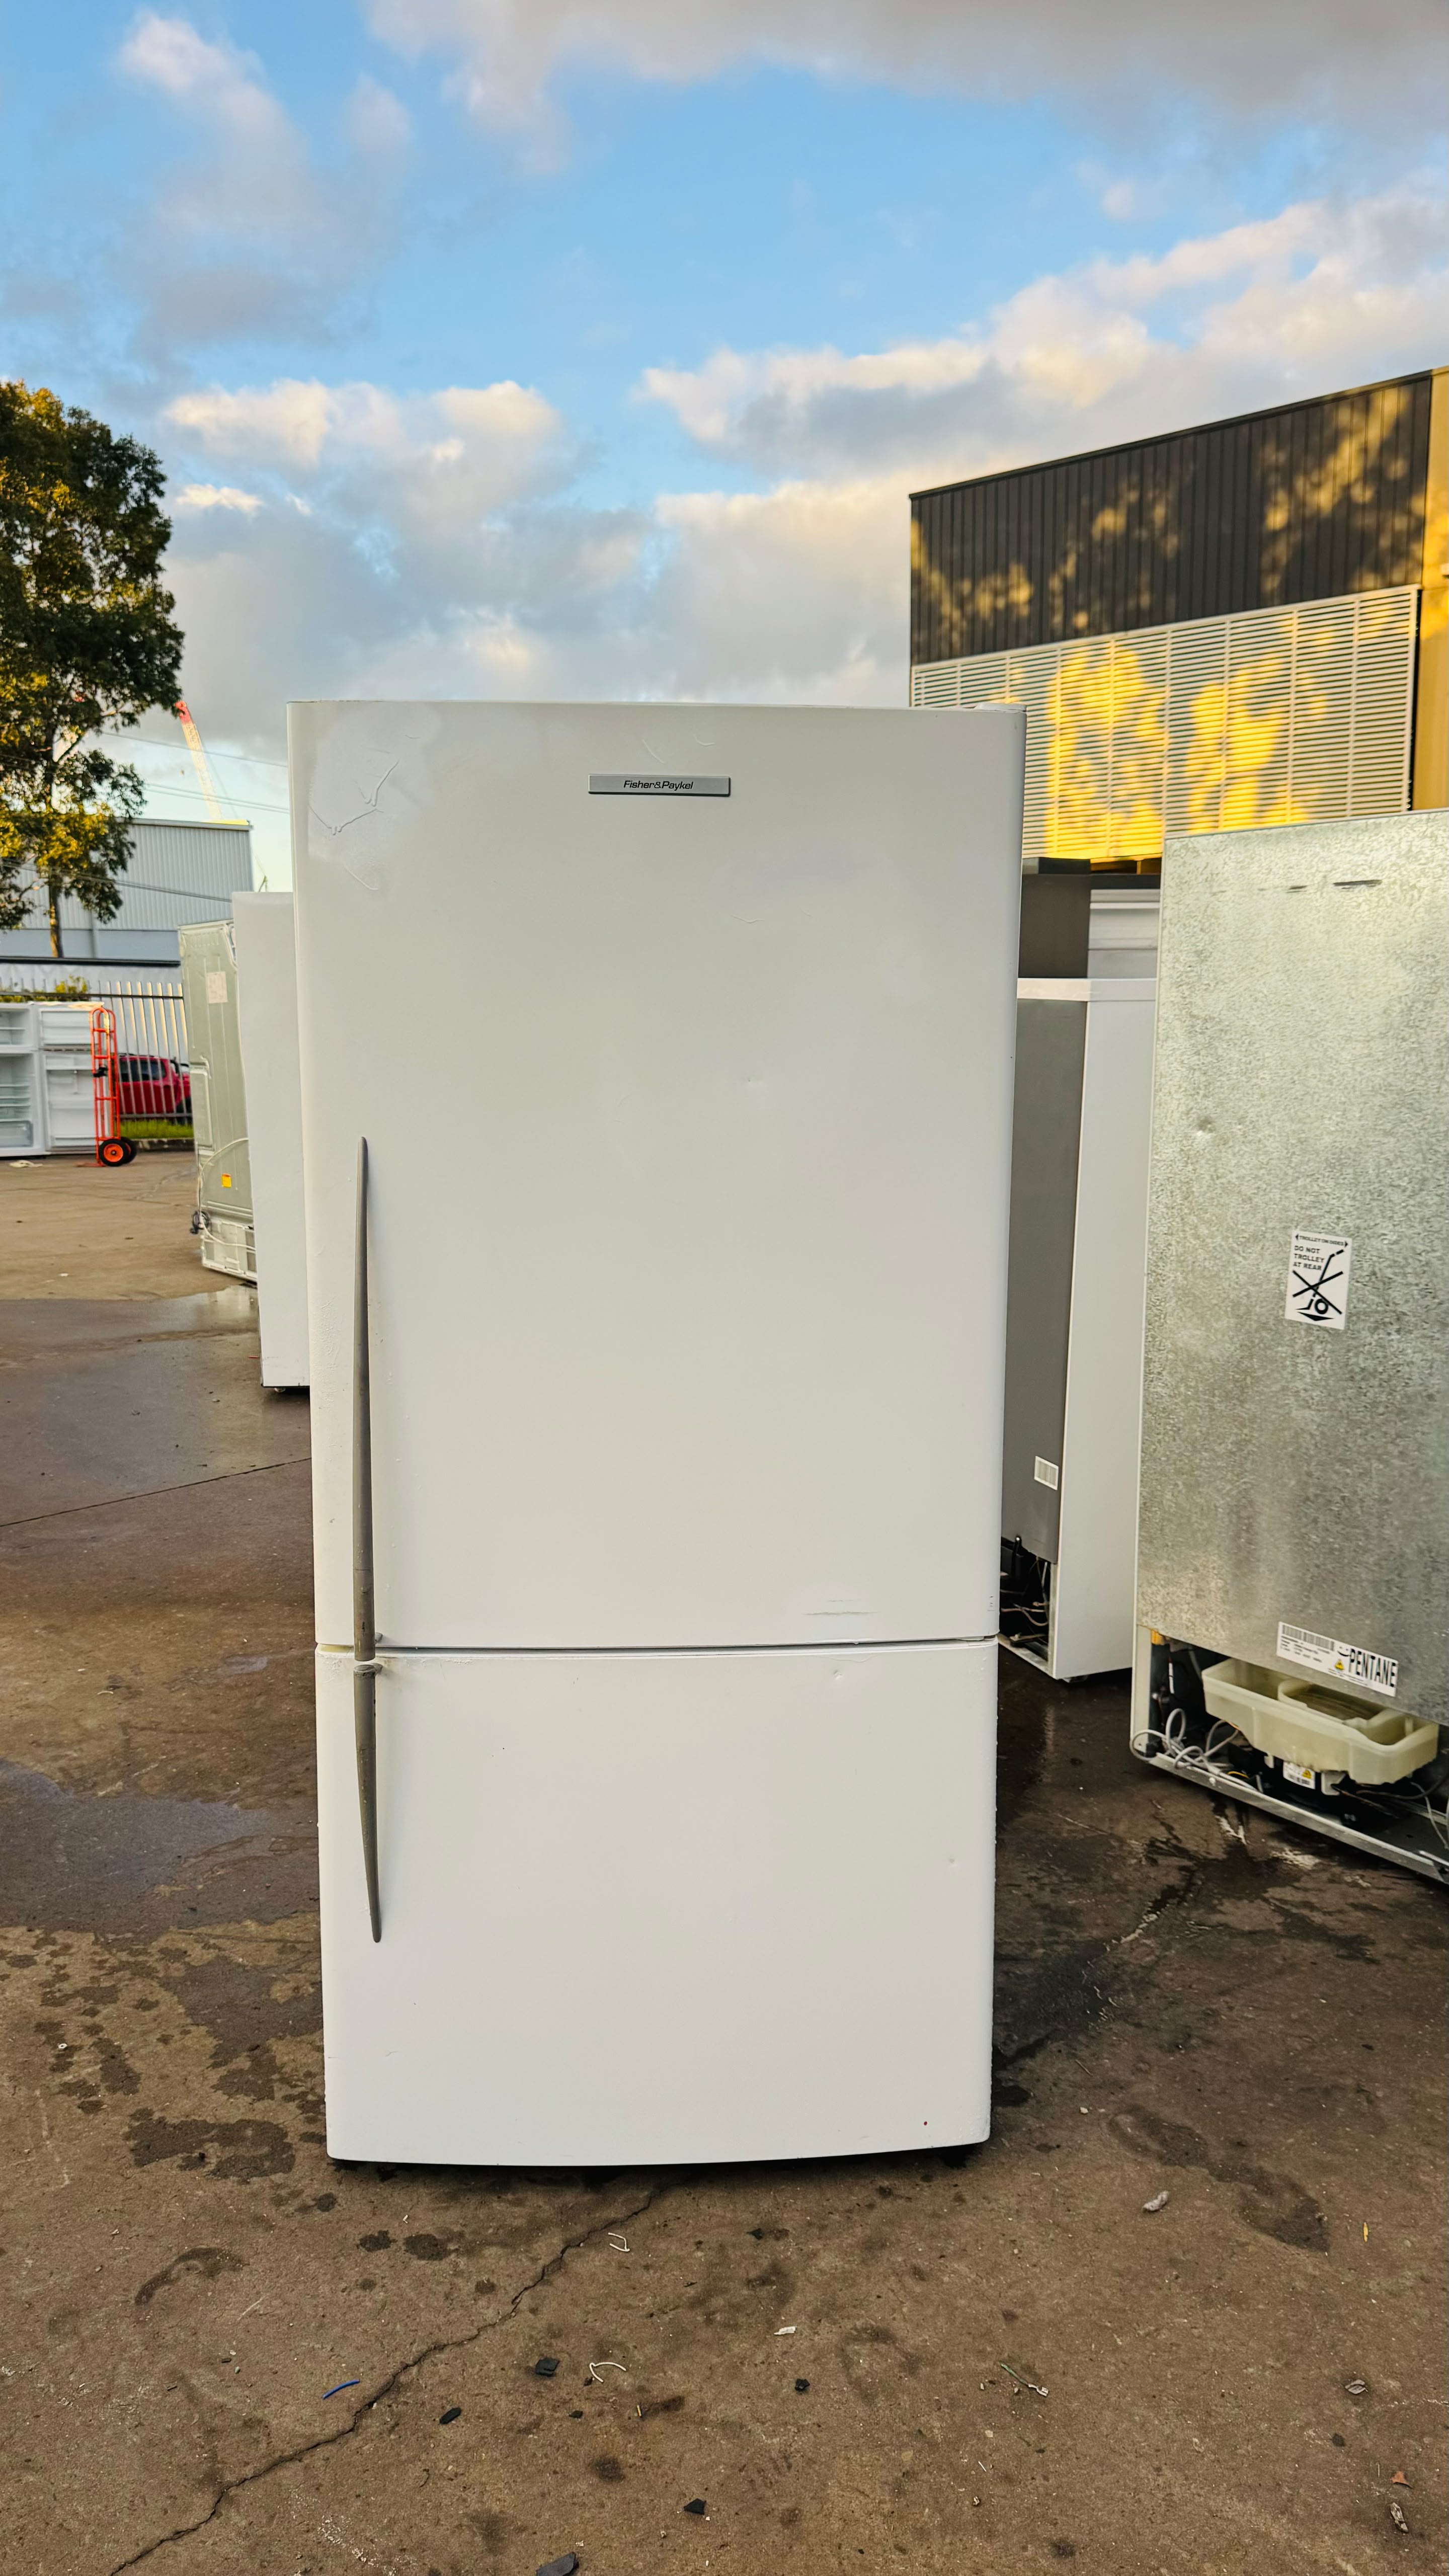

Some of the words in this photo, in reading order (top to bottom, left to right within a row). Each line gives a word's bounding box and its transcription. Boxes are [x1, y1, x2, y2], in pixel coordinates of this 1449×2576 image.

[623, 780, 694, 791] Fisher&Paykel
[1294, 1253, 1324, 1262] TROLLEY
[1348, 1648, 1396, 1687] PENTANE
